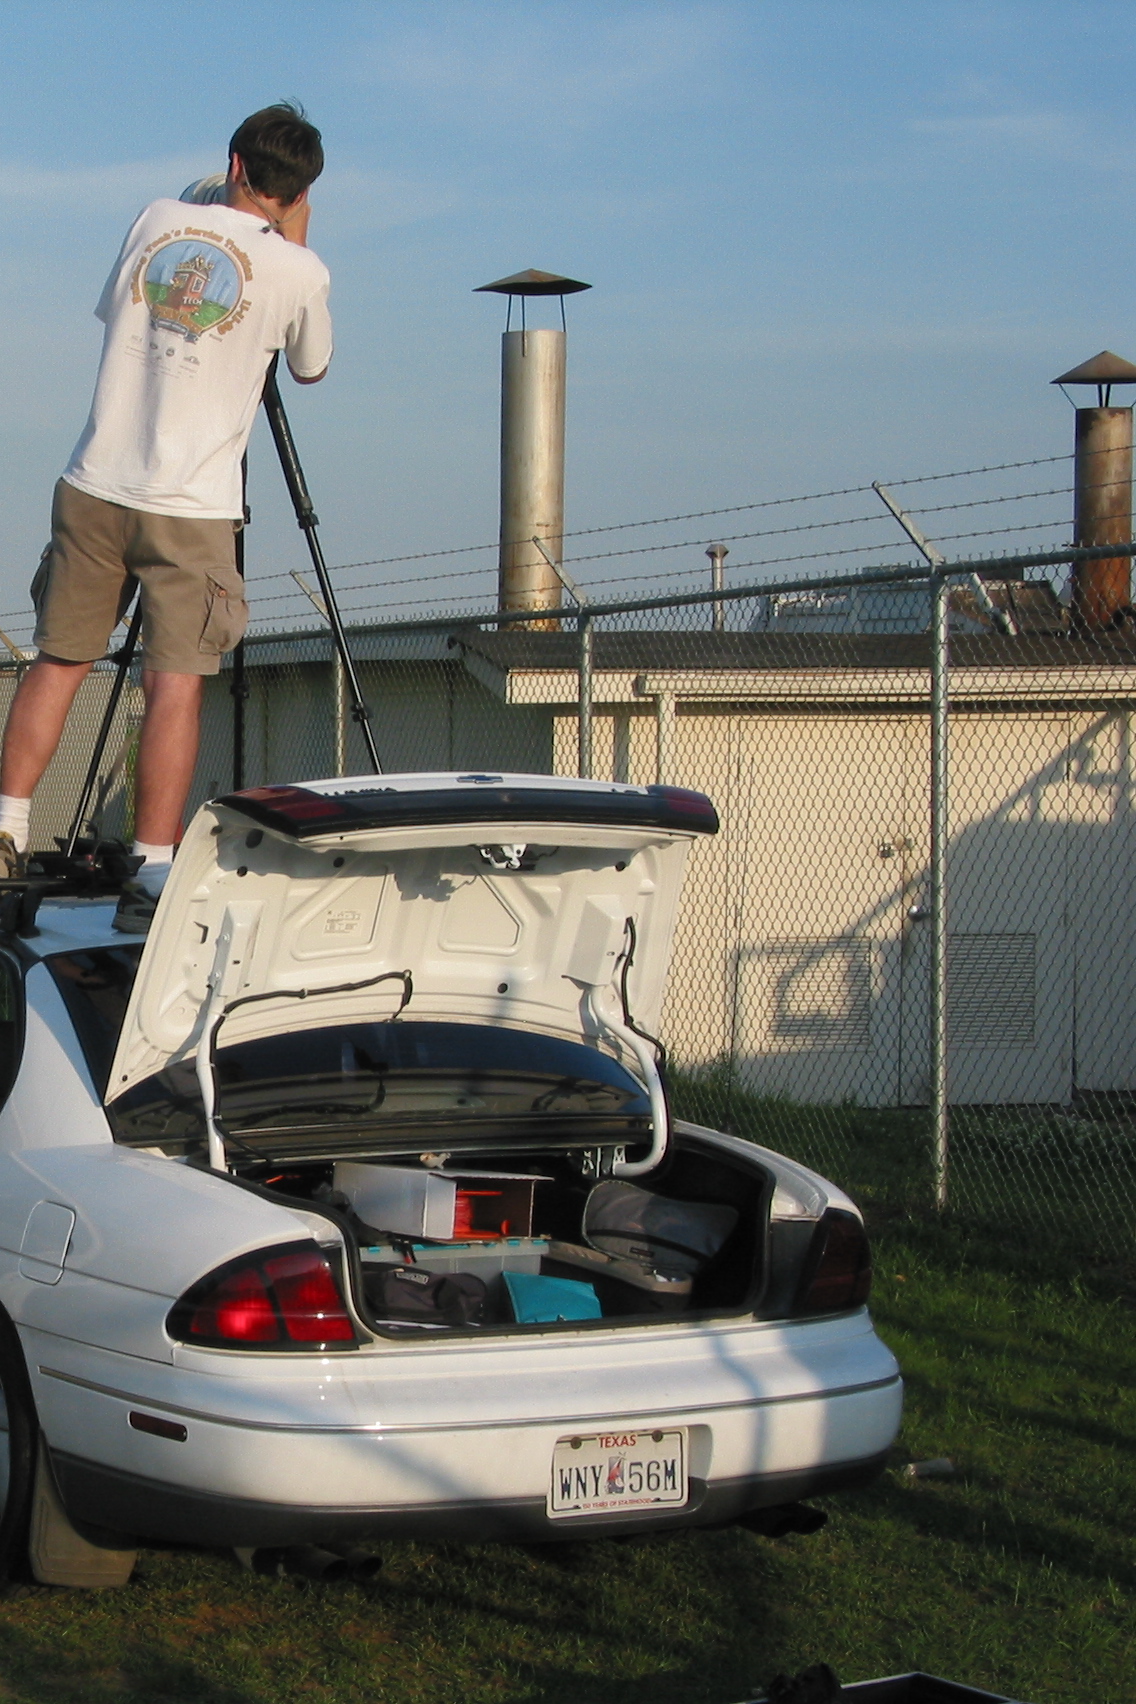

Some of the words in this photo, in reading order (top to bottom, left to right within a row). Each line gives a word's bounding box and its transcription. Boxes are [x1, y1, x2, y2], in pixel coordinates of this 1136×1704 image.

[598, 1434, 637, 1448] TEXAS
[559, 1464, 604, 1500] WNY
[628, 1459, 677, 1493] 56M
[618, 1497, 652, 1505] STATEHOOD
